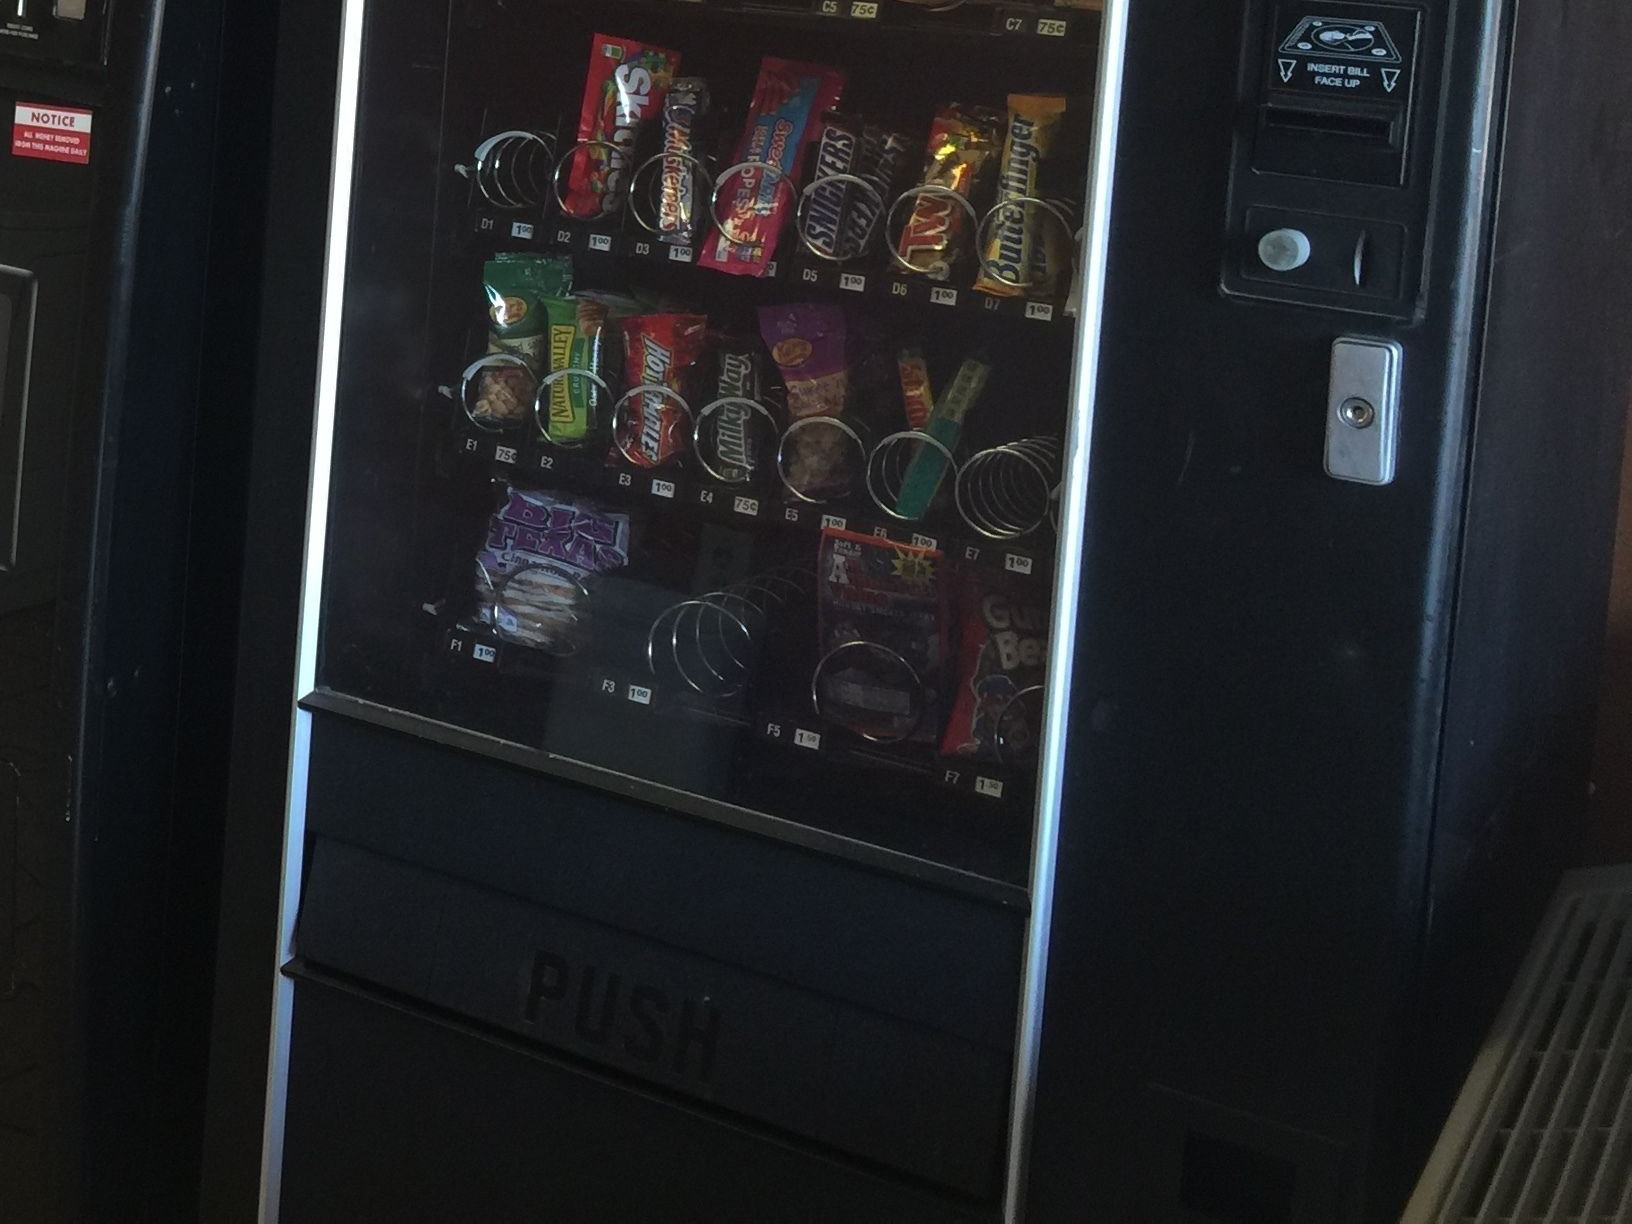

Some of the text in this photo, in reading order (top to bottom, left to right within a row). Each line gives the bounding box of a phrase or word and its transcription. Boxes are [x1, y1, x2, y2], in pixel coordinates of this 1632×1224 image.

[822, 0, 837, 13] C5
[1006, 18, 1022, 31] C7
[1306, 62, 1370, 77] INSERT BILL
[1314, 76, 1361, 88] FACE UP
[31, 112, 75, 128] NOTICE
[991, 116, 1041, 283] Butterfinger
[481, 218, 494, 230] D1
[557, 230, 571, 243] D2
[636, 242, 650, 255] D3
[802, 268, 818, 282] D5
[892, 282, 908, 296] D6
[984, 296, 1000, 310] D7
[552, 327, 572, 370] VALLEY
[718, 353, 754, 470] Milky Way
[466, 439, 478, 452] E1
[540, 455, 553, 469] E2
[619, 472, 632, 486] E3
[700, 489, 713, 503] E4
[785, 508, 798, 521] E5
[965, 547, 980, 560] E7
[450, 638, 462, 652] F1
[602, 680, 616, 693] F3
[767, 722, 781, 737] F5
[945, 770, 960, 784] F7
[525, 947, 723, 1074] PUSH
